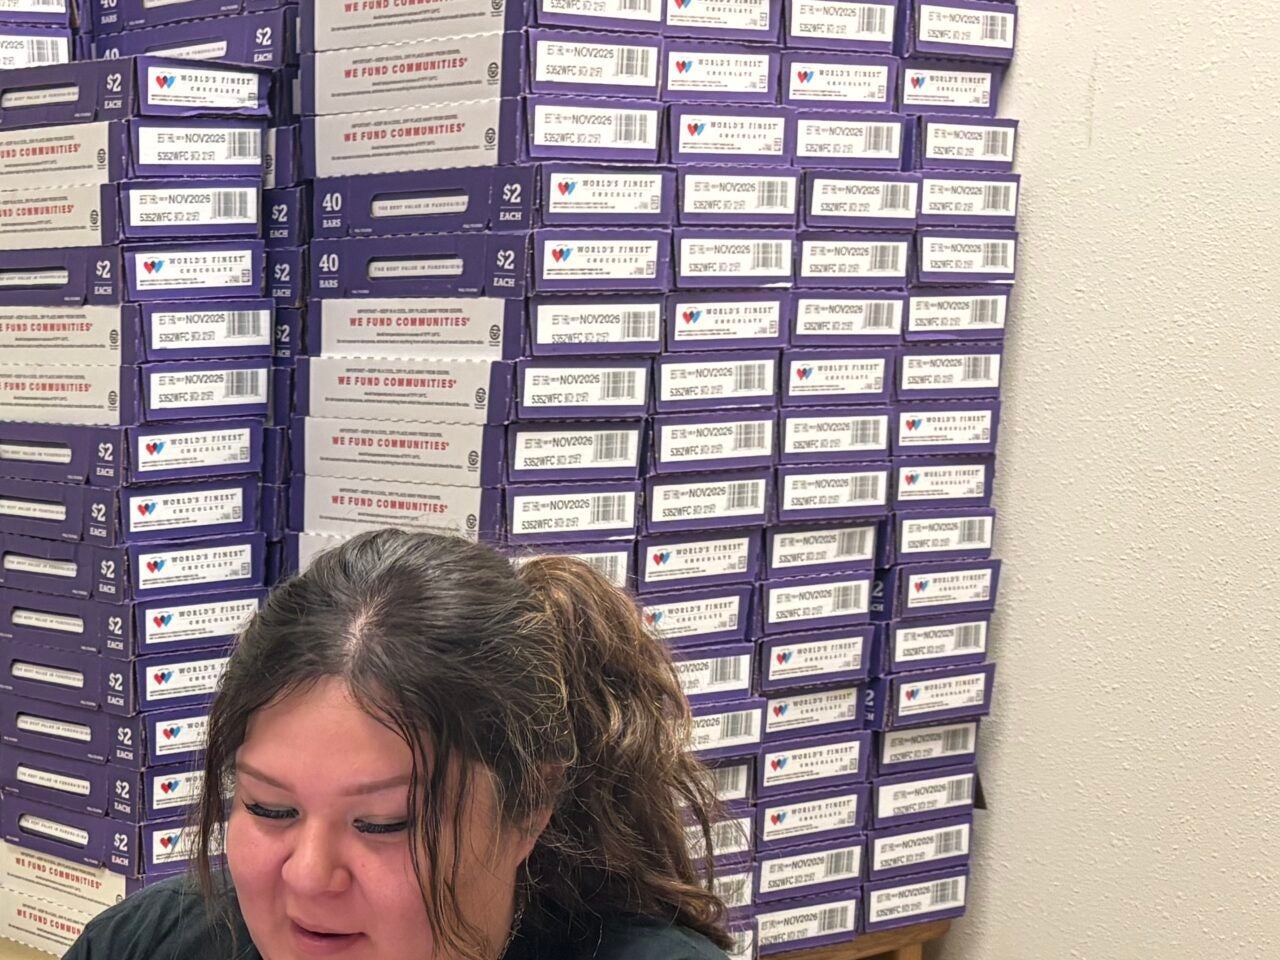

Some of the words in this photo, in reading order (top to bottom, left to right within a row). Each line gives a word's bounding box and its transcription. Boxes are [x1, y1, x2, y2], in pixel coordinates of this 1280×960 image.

[256, 27, 271, 46] $2
[254, 53, 272, 62] EACH
[344, 69, 358, 78] WE
[362, 66, 388, 76] FUND
[106, 74, 121, 91] $2
[104, 100, 122, 109] EACH
[503, 184, 521, 203] $2
[322, 193, 342, 212] 40
[272, 204, 288, 222] $2
[500, 212, 522, 221] EACH
[323, 219, 341, 228] BARS
[270, 230, 288, 238] EACH
[319, 254, 339, 272] 40
[497, 250, 515, 270] $2
[96, 260, 111, 278] $2
[320, 279, 338, 288] BARS
[493, 277, 515, 287] EACH
[94, 286, 112, 294] EACH
[350, 318, 362, 326] WE
[366, 317, 392, 326] FUND
[7, 323, 27, 332] FUND
[338, 376, 352, 385] WE
[355, 377, 380, 386] FUND
[332, 436, 346, 445] WE
[349, 437, 374, 447] FUND
[98, 443, 113, 461] $2
[96, 467, 114, 476] EACH
[332, 496, 346, 504] WE
[348, 497, 373, 508] FUND
[108, 617, 122, 635] $2
[107, 641, 123, 650] EACH
[114, 833, 128, 851] $2
[15, 857, 26, 866] WE
[28, 860, 47, 874] FUND
[112, 856, 128, 866] EACH
